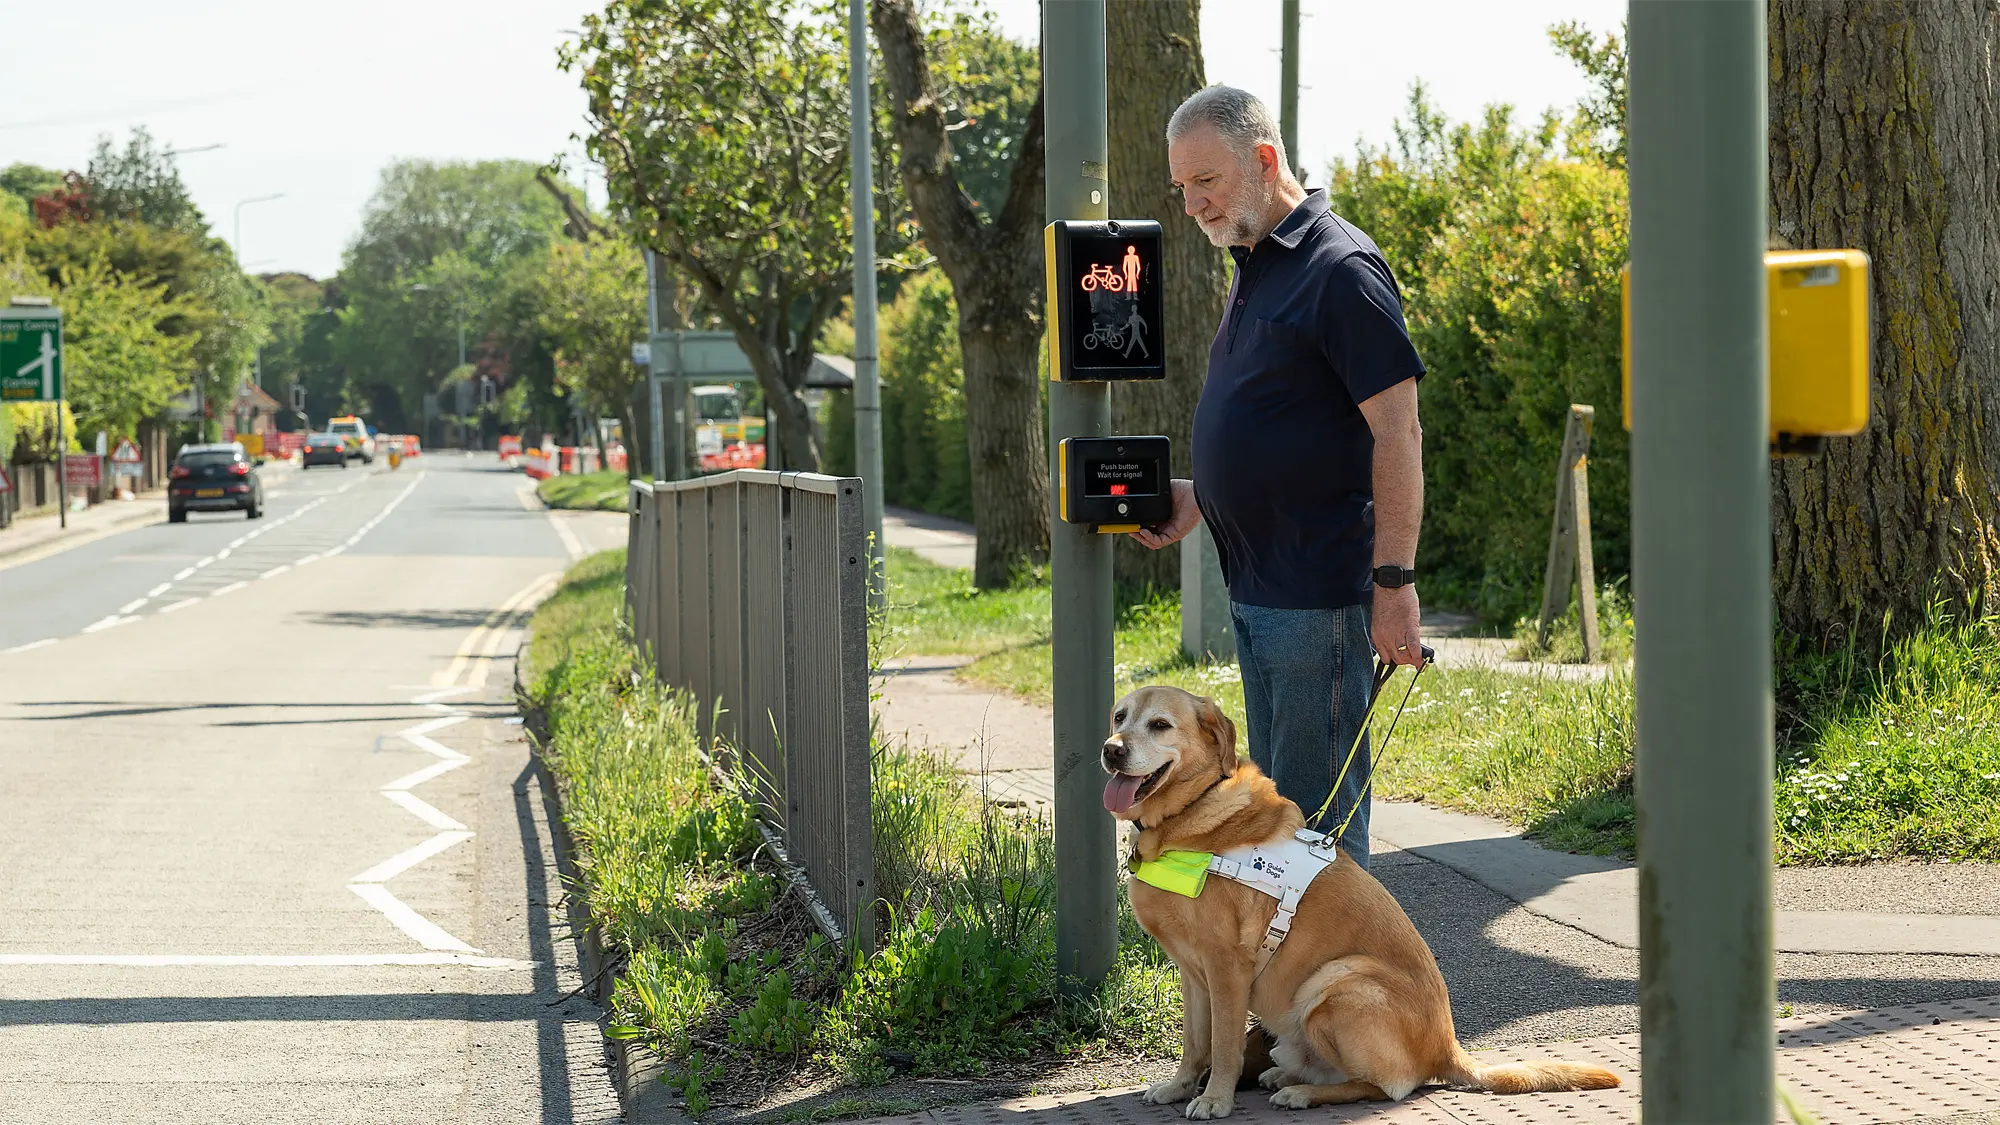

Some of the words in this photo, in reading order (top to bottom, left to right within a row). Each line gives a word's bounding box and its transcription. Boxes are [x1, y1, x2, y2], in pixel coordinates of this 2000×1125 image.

[0, 322, 20, 330] own
[1097, 471, 1112, 479] Wait
[1123, 471, 1142, 480] signal
[1265, 867, 1281, 879] Dogs
[1267, 862, 1285, 874] Guide
